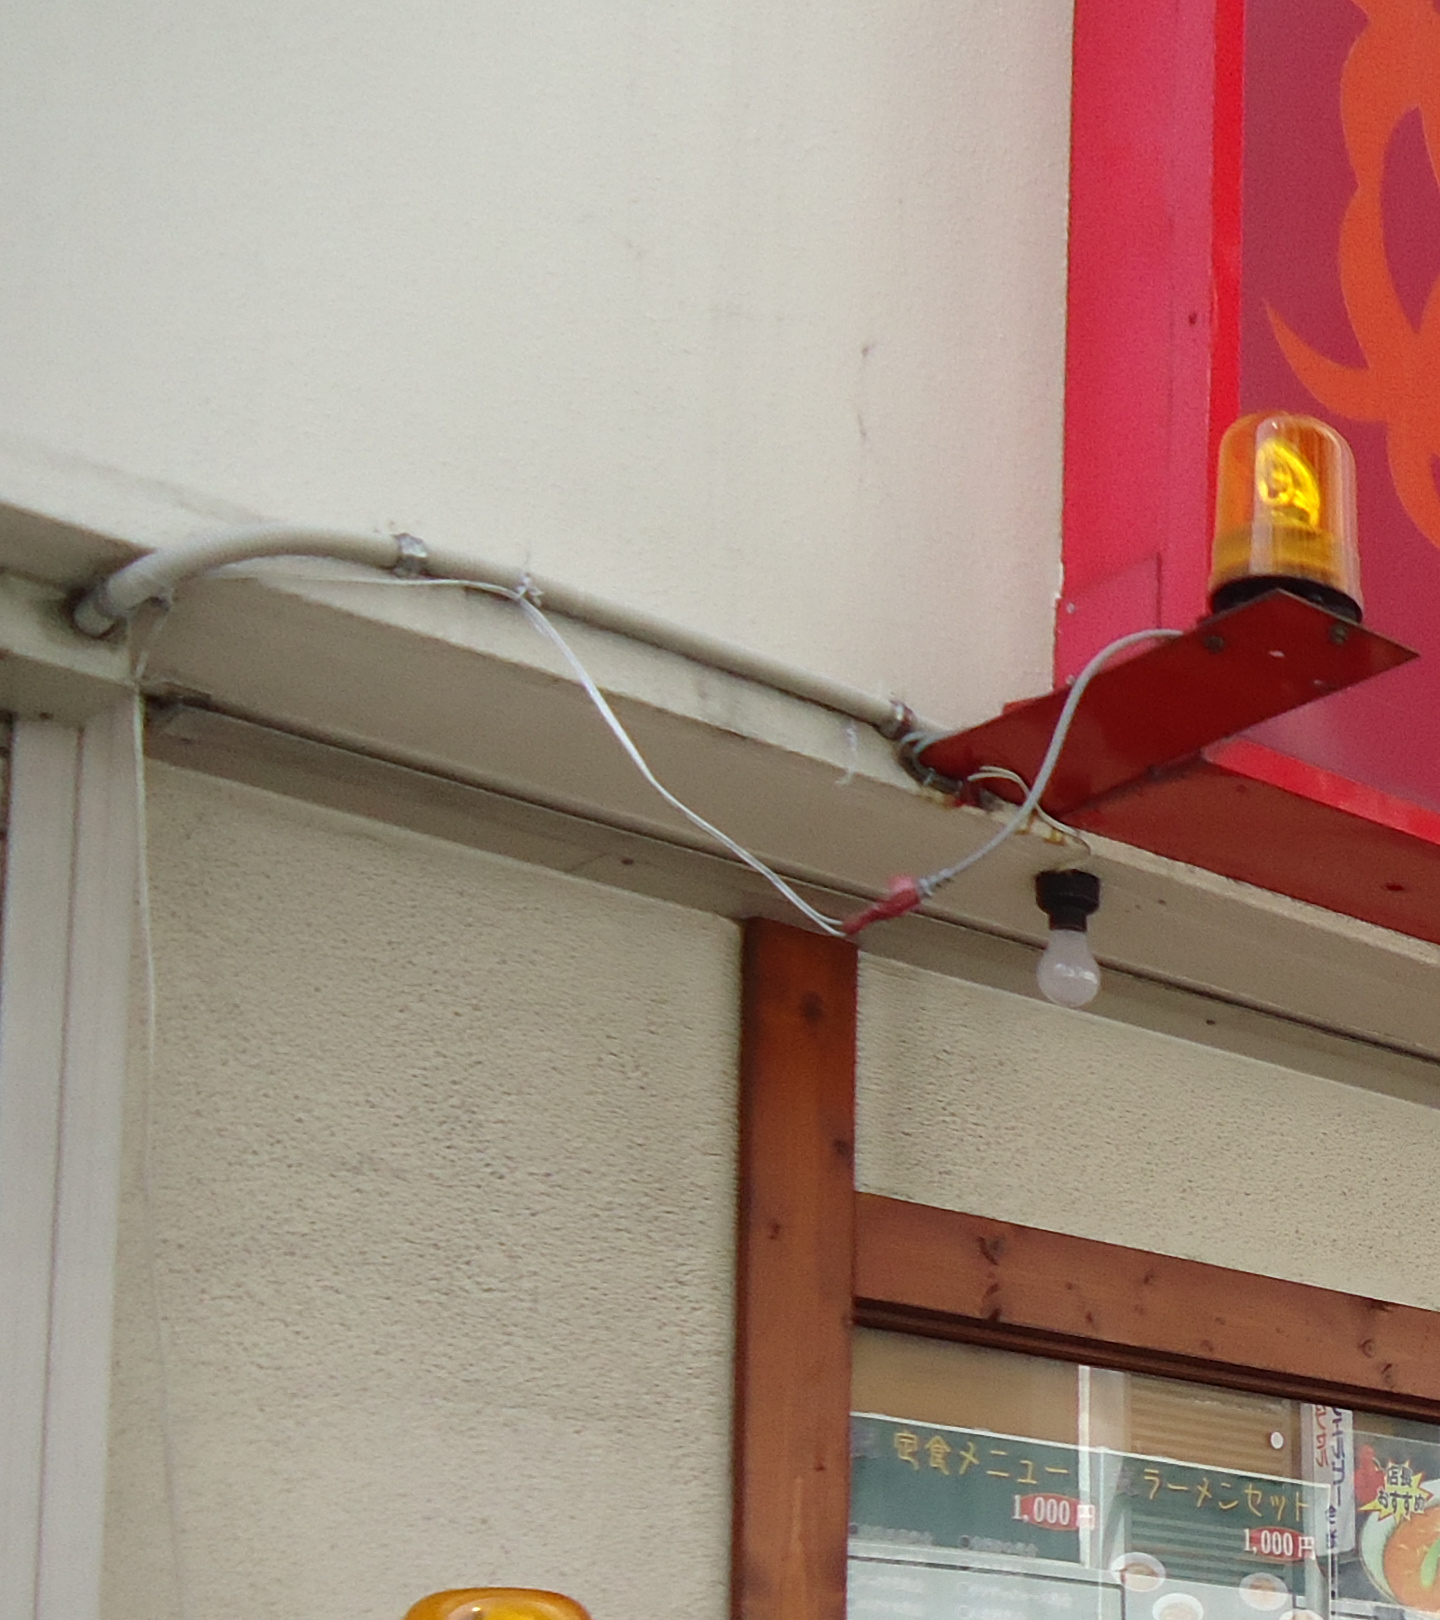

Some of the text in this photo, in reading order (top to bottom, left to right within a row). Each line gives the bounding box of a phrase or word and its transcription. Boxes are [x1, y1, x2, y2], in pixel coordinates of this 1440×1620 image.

[893, 1430, 1070, 1485] 定食メニュー
[1386, 1465, 1413, 1487] 店長
[1143, 1467, 1310, 1522] ラーメンセット
[1377, 1489, 1426, 1515] おすすめ
[1243, 1527, 1315, 1560] 1,000円
